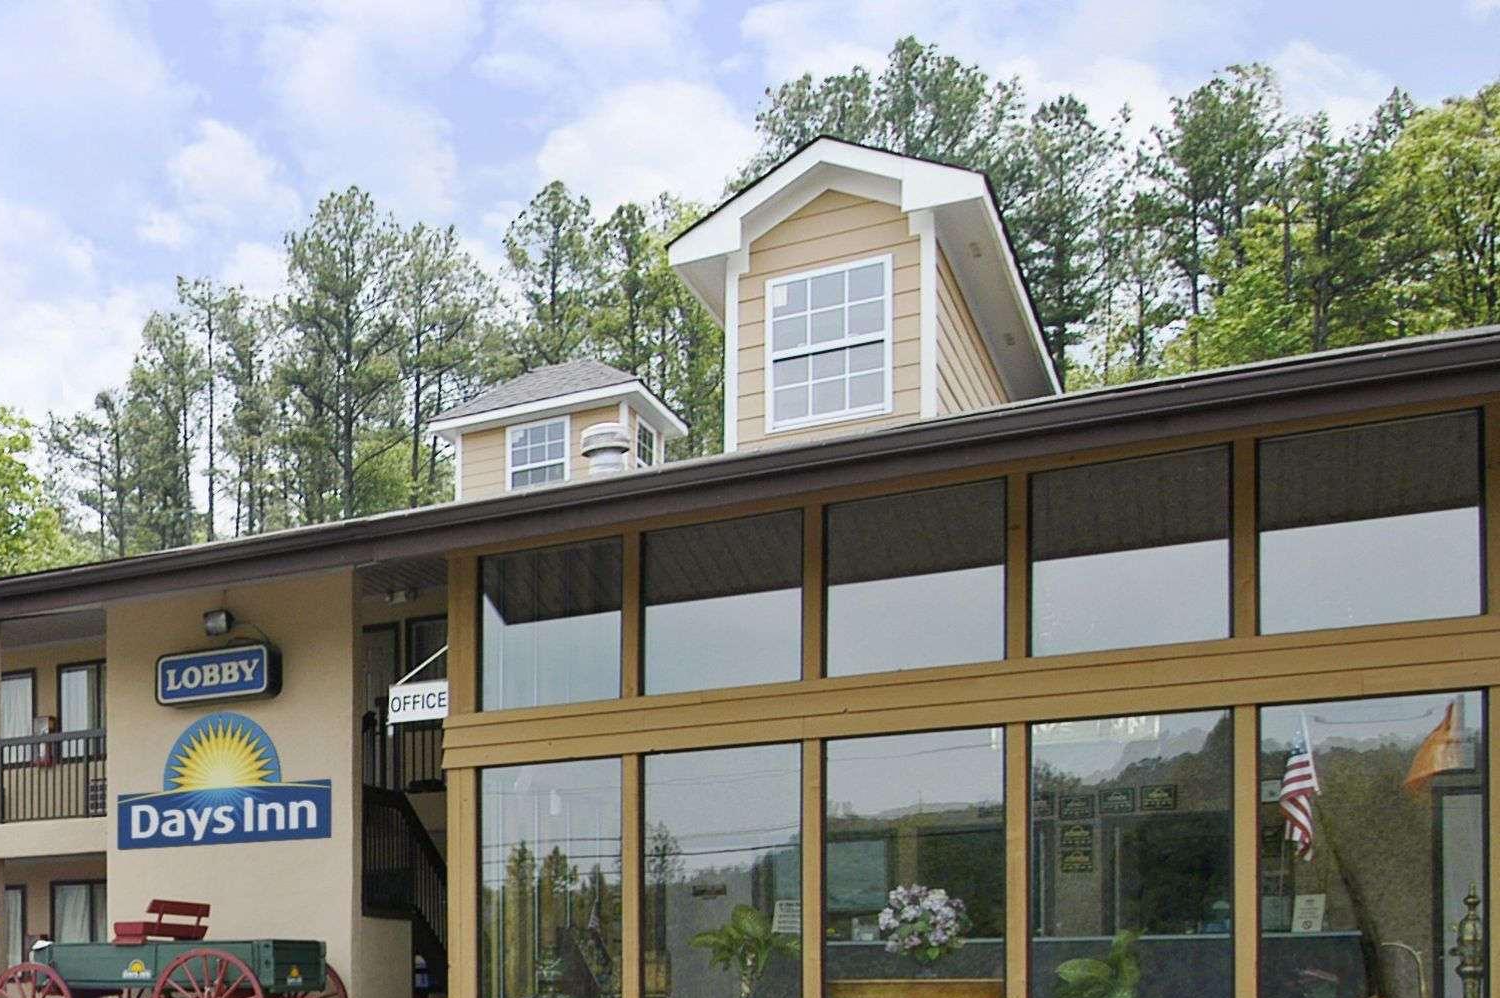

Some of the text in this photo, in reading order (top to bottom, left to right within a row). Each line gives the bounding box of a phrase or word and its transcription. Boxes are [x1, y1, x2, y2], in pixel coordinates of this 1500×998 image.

[166, 659, 259, 691] LOBBY
[390, 691, 447, 713] OFFICE
[131, 797, 317, 841] Days Inn
